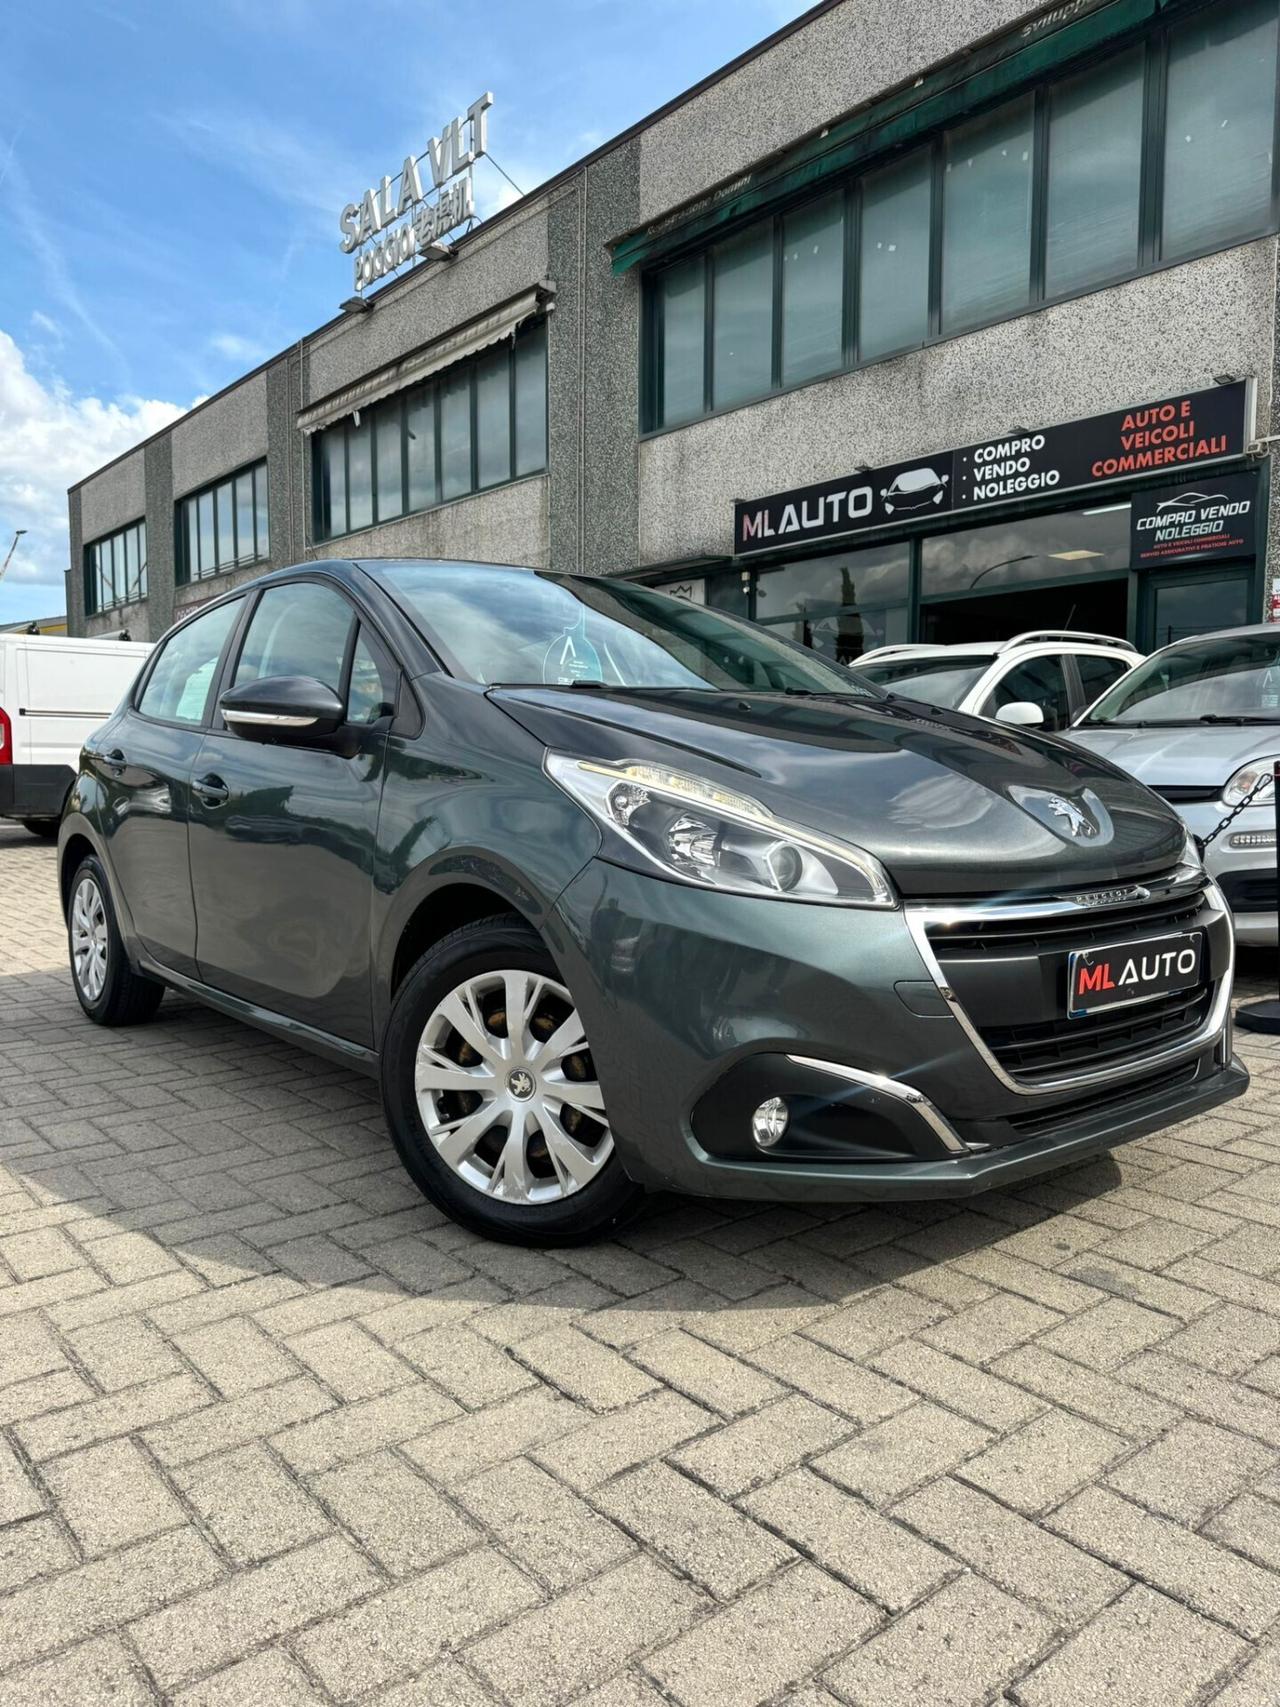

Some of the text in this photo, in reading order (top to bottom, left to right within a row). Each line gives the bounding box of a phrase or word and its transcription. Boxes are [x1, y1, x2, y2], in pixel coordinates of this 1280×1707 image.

[1020, 0, 1087, 38] svilupp
[339, 91, 494, 254] SALA VLT
[1120, 400, 1191, 431] AUTO E
[974, 435, 1045, 463] COMPRO
[1120, 421, 1195, 450] VEICOLI
[973, 457, 1031, 482] VENDO
[1091, 435, 1227, 478] COMMERCIALI
[973, 469, 1060, 501] NOLEGGIO
[742, 486, 873, 542] ML AUTO
[1136, 500, 1251, 531] COMPRO VENDO
[1155, 520, 1224, 542] NOLEGGIO
[1078, 949, 1196, 995] ML AUTO
